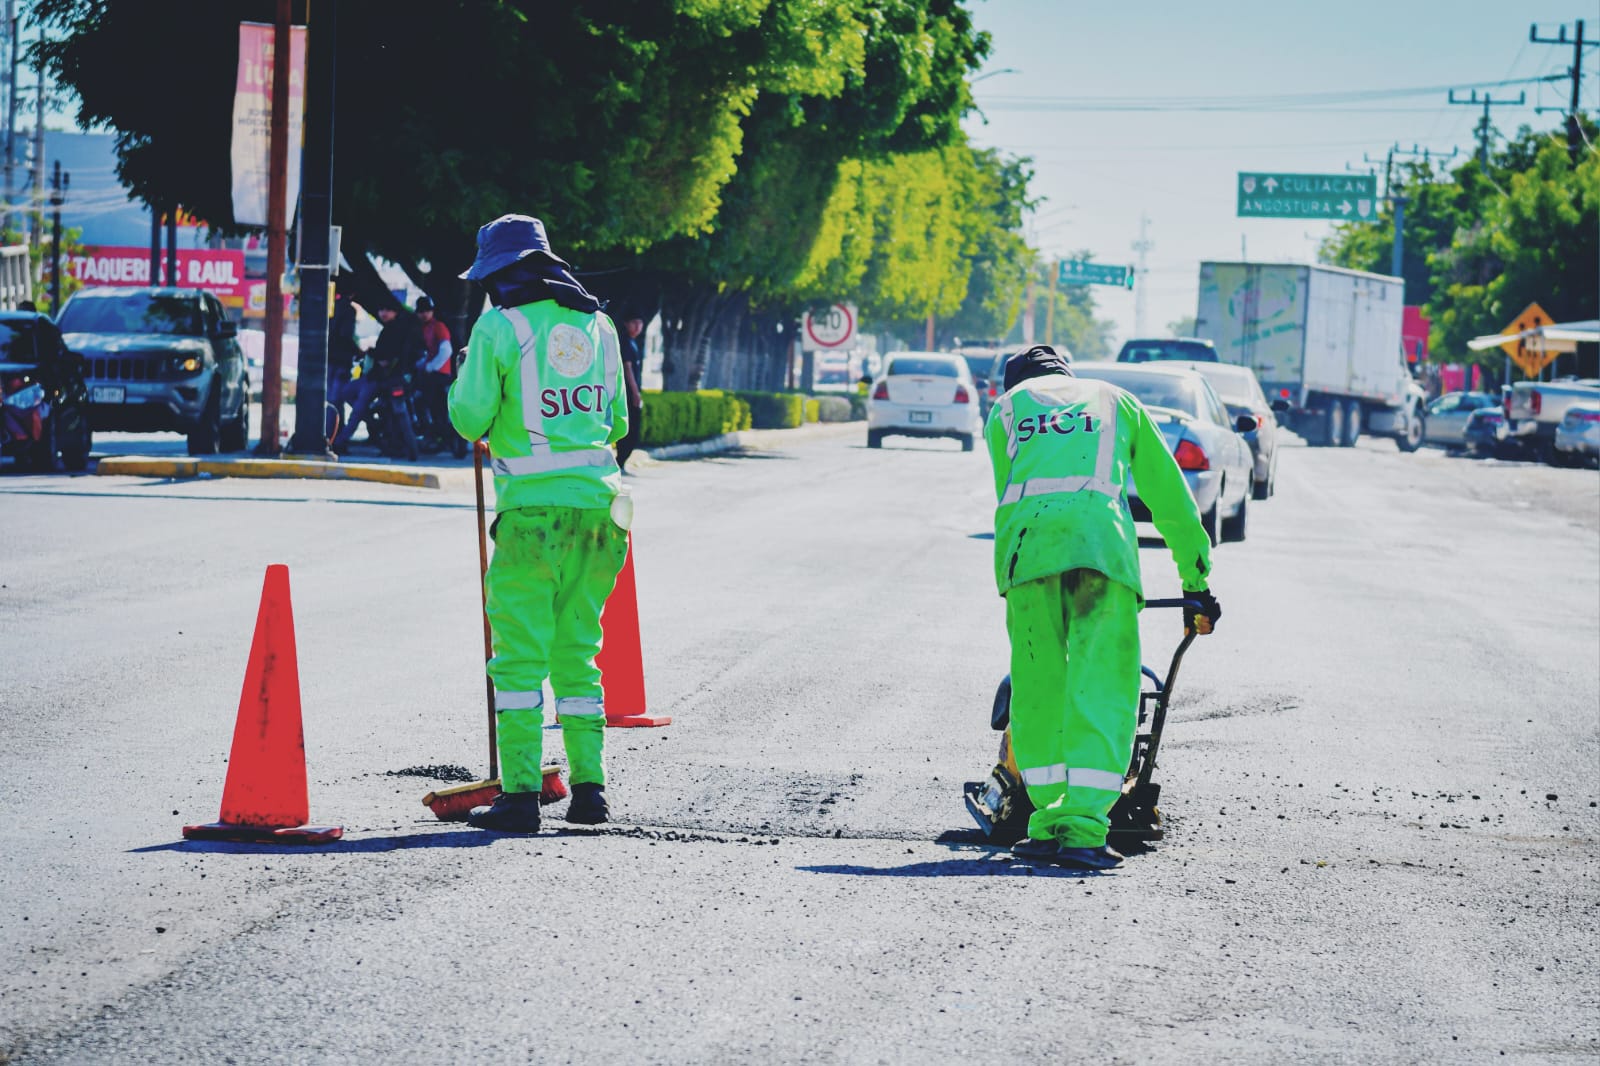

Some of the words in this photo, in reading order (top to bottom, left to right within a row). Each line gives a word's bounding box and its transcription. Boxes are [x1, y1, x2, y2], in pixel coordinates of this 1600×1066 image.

[1282, 178, 1367, 193] CULIACAN
[1243, 199, 1331, 214] ANGOSTURA
[187, 259, 239, 285] RAUL
[540, 384, 606, 419] SICT
[1017, 411, 1099, 442] SICT
